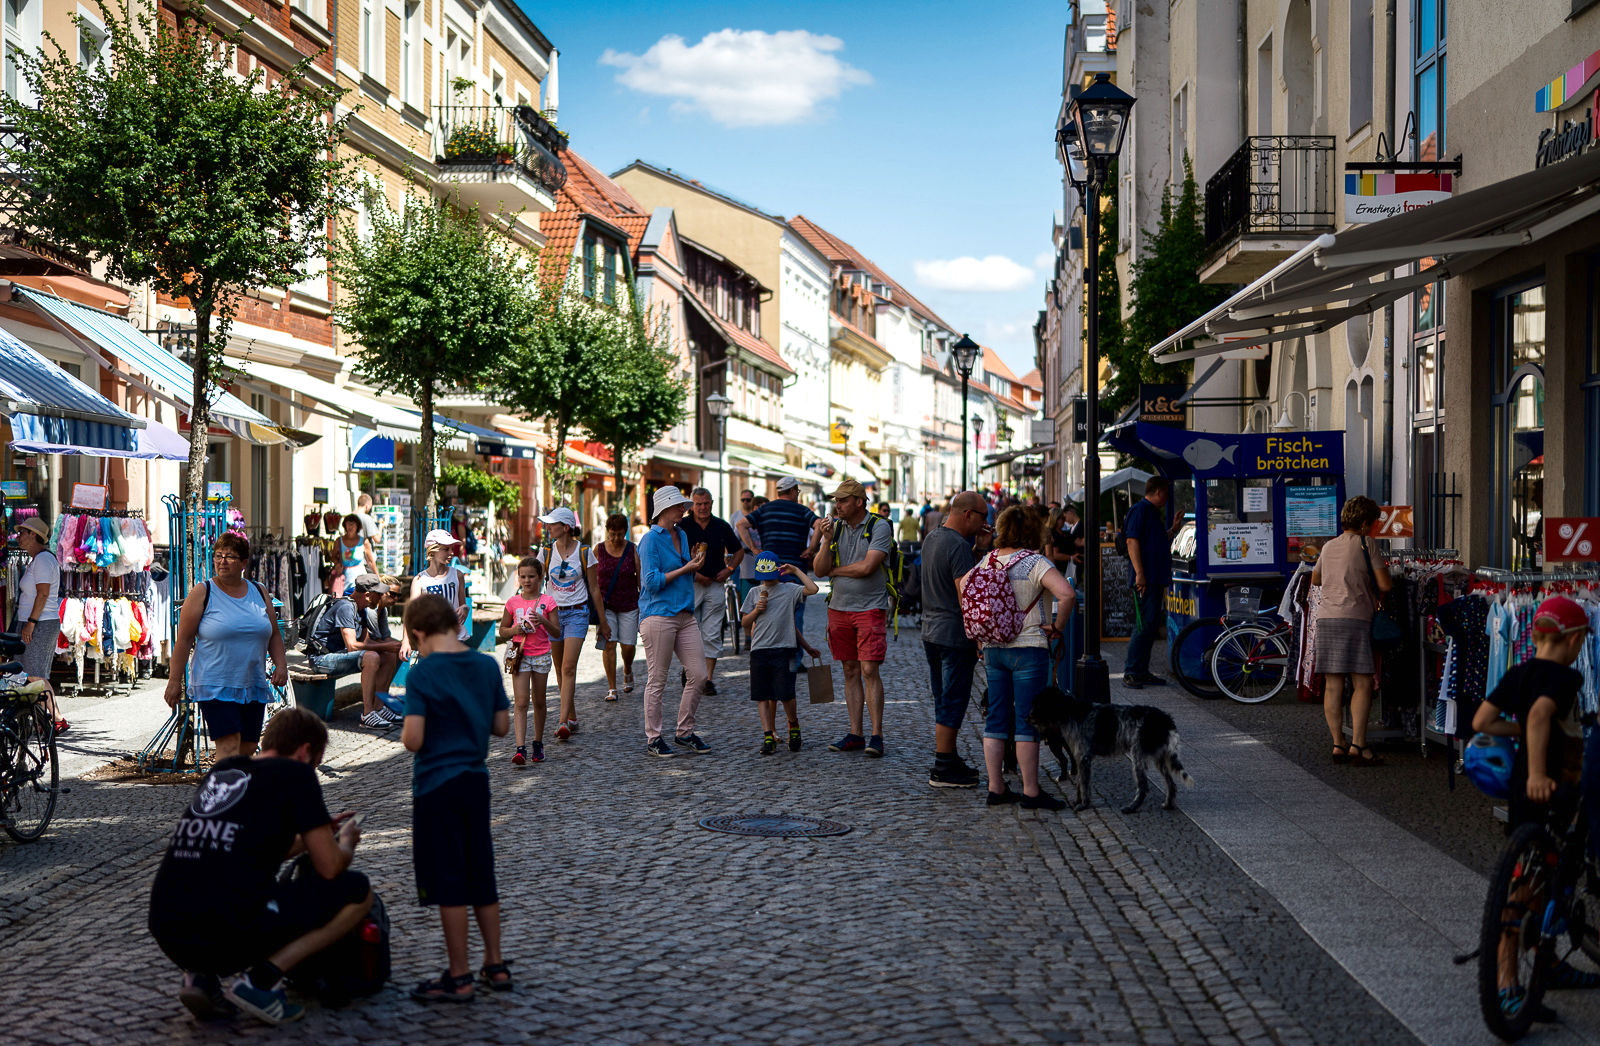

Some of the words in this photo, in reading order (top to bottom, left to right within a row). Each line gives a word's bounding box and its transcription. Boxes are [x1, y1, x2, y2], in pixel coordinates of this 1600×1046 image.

[1355, 203, 1401, 217] Ernsting's
[1144, 396, 1181, 413] K&C
[1266, 435, 1323, 454] Fisch-
[1256, 454, 1329, 470] brötchen
[1558, 522, 1593, 557] %
[175, 818, 239, 842] TONE
